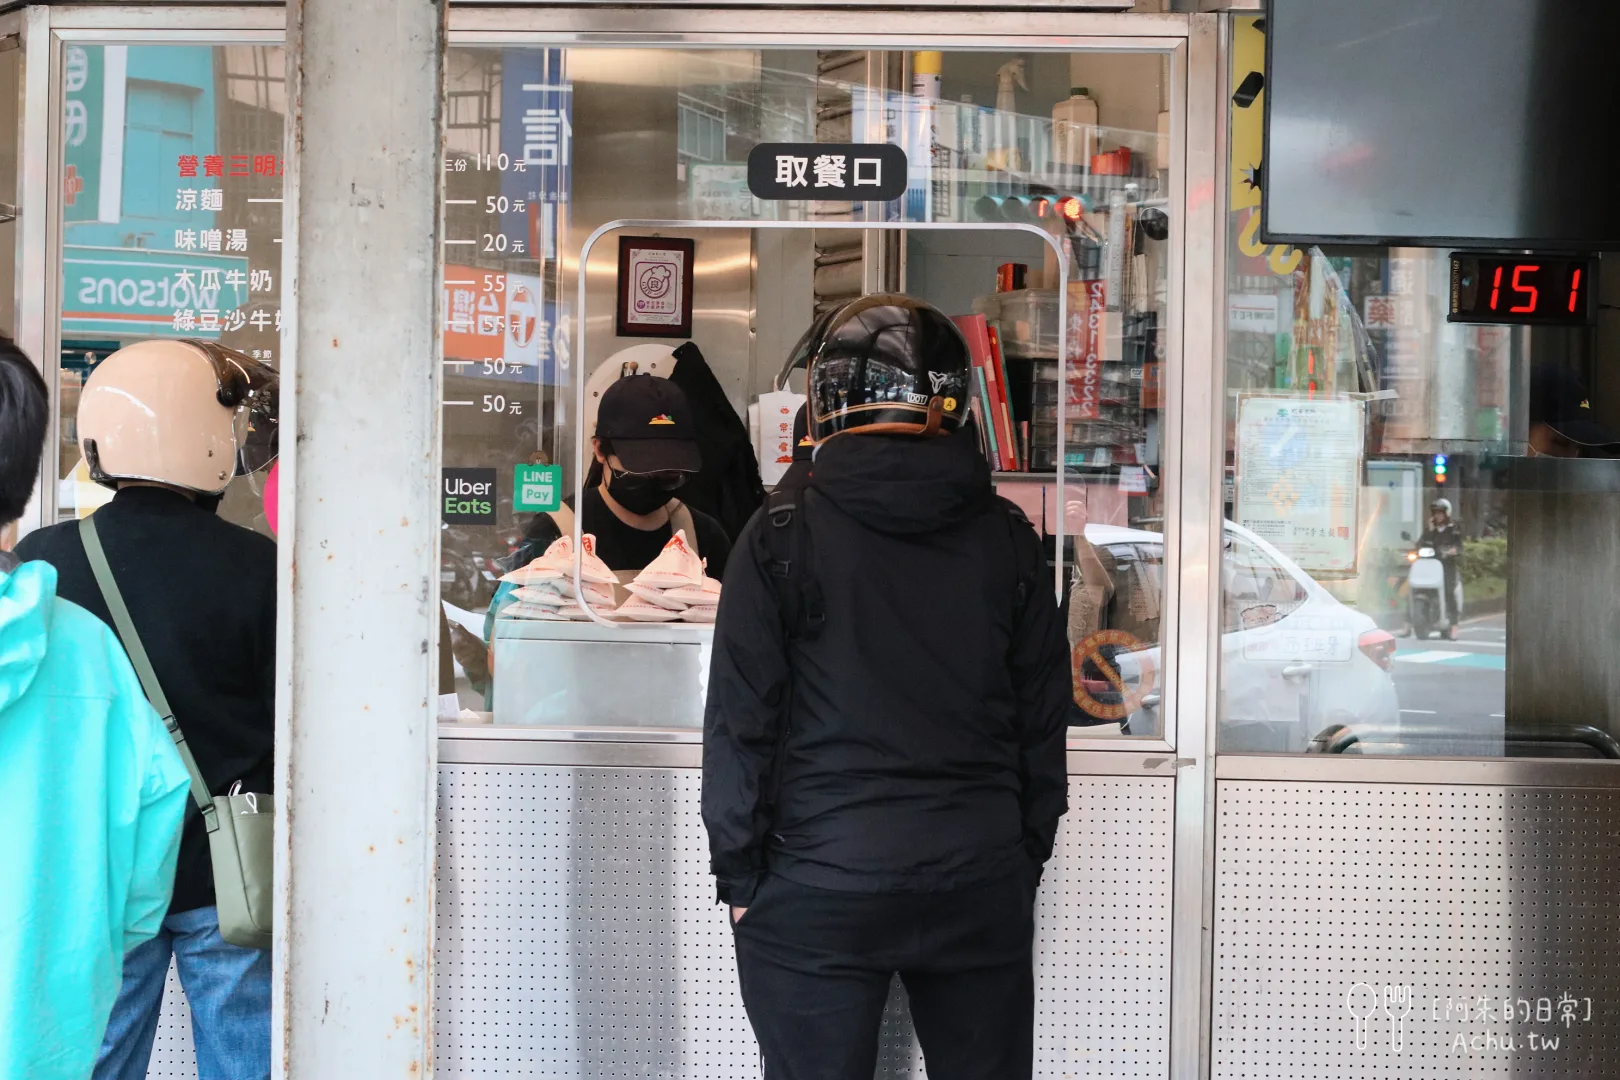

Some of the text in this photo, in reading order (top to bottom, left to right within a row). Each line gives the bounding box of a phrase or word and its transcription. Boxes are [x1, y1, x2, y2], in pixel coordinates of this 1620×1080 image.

[177, 154, 284, 177] 營養三明
[477, 153, 509, 171] 110
[513, 159, 526, 172] 元
[775, 154, 882, 187] 取餐口
[176, 188, 223, 211] 涼麵
[485, 196, 526, 213] 50 元
[174, 228, 248, 251] 味噌湯
[483, 234, 525, 253] 20 元
[174, 269, 272, 291] 木瓜牛奶
[483, 275, 524, 293] 55 元
[483, 316, 505, 333] 55
[482, 358, 523, 375] 50 元
[482, 395, 522, 415] 50 元
[910, 395, 925, 404] DOT
[523, 471, 553, 483] LINE
[445, 478, 492, 495] Uber
[526, 489, 549, 501] Pay
[445, 498, 492, 514] Eats
